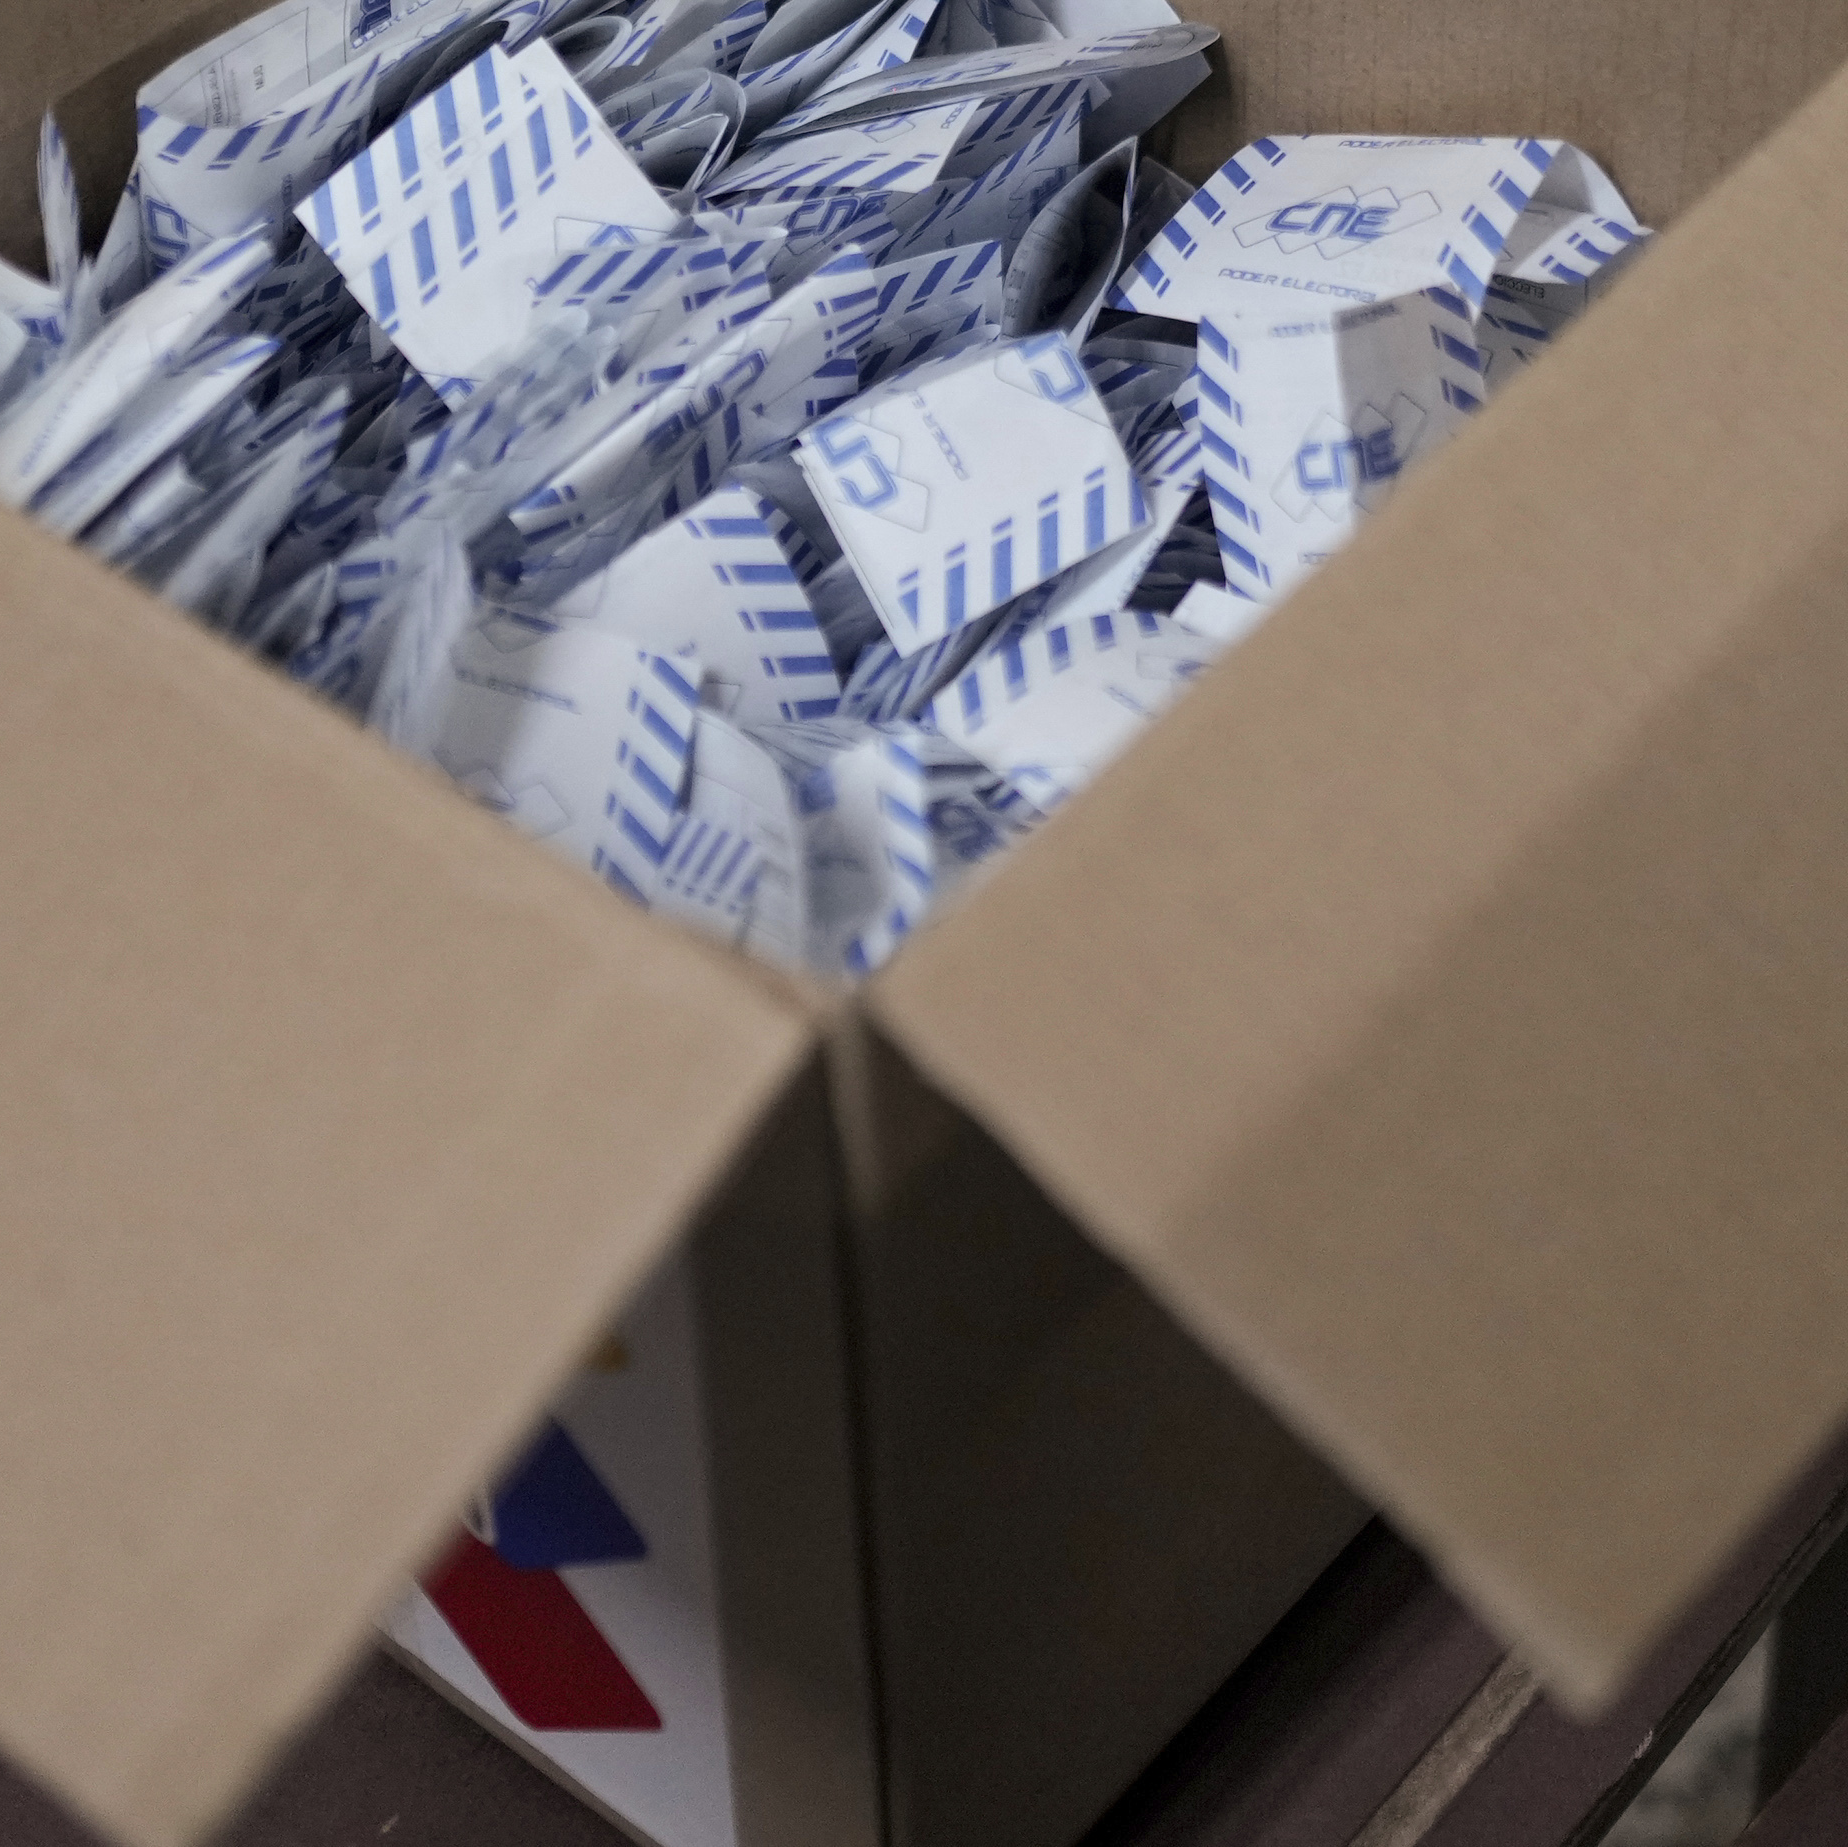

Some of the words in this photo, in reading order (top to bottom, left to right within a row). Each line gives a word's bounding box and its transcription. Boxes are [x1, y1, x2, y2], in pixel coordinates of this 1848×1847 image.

[1265, 202, 1394, 242] CNE
[1218, 267, 1280, 286] PODER
[1294, 427, 1402, 496] CNE
